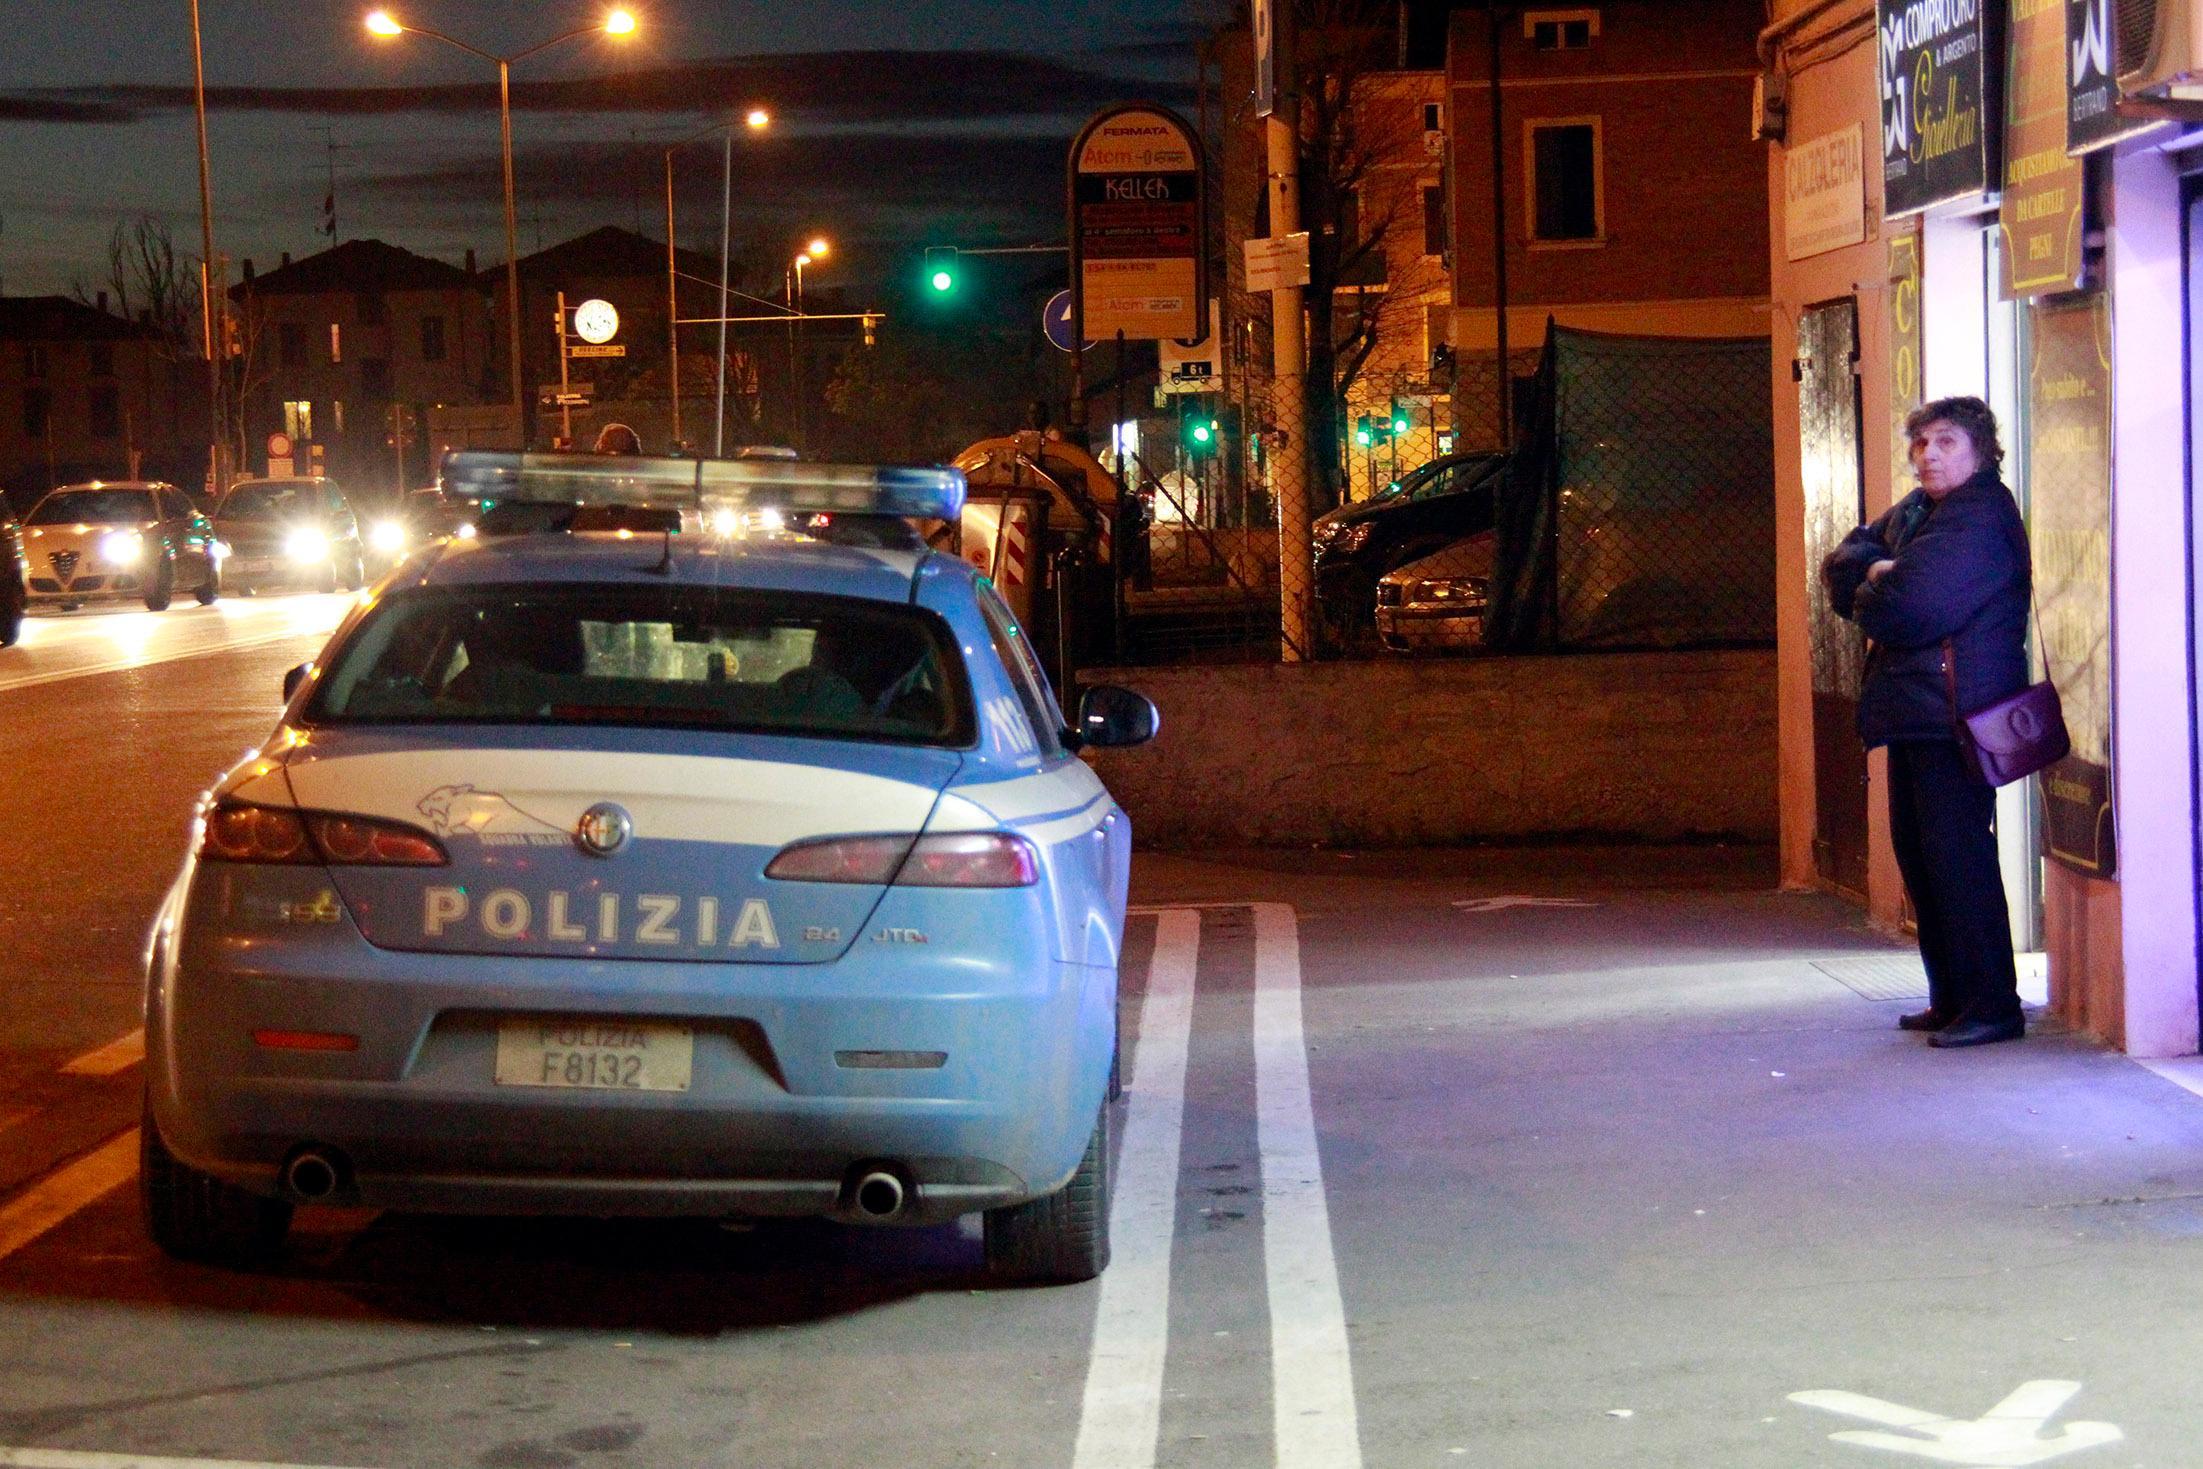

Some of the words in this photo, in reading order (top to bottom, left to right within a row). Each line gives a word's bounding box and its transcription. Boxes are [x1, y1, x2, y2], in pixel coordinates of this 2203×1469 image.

[1905, 0, 1950, 49] COMPRO
[1951, 0, 1976, 28] ORO
[1943, 33, 1977, 63] ARGENTO
[1910, 50, 1976, 164] Gioielleria
[1103, 127, 1169, 136] FERMATA
[1788, 134, 1860, 202] CALZOLERIA
[1106, 178, 1169, 200] KELLER
[1190, 364, 1197, 375] 6
[423, 886, 780, 948] POLIZIA
[540, 1028, 647, 1049] POLIZIA
[543, 1051, 642, 1088] F8132
